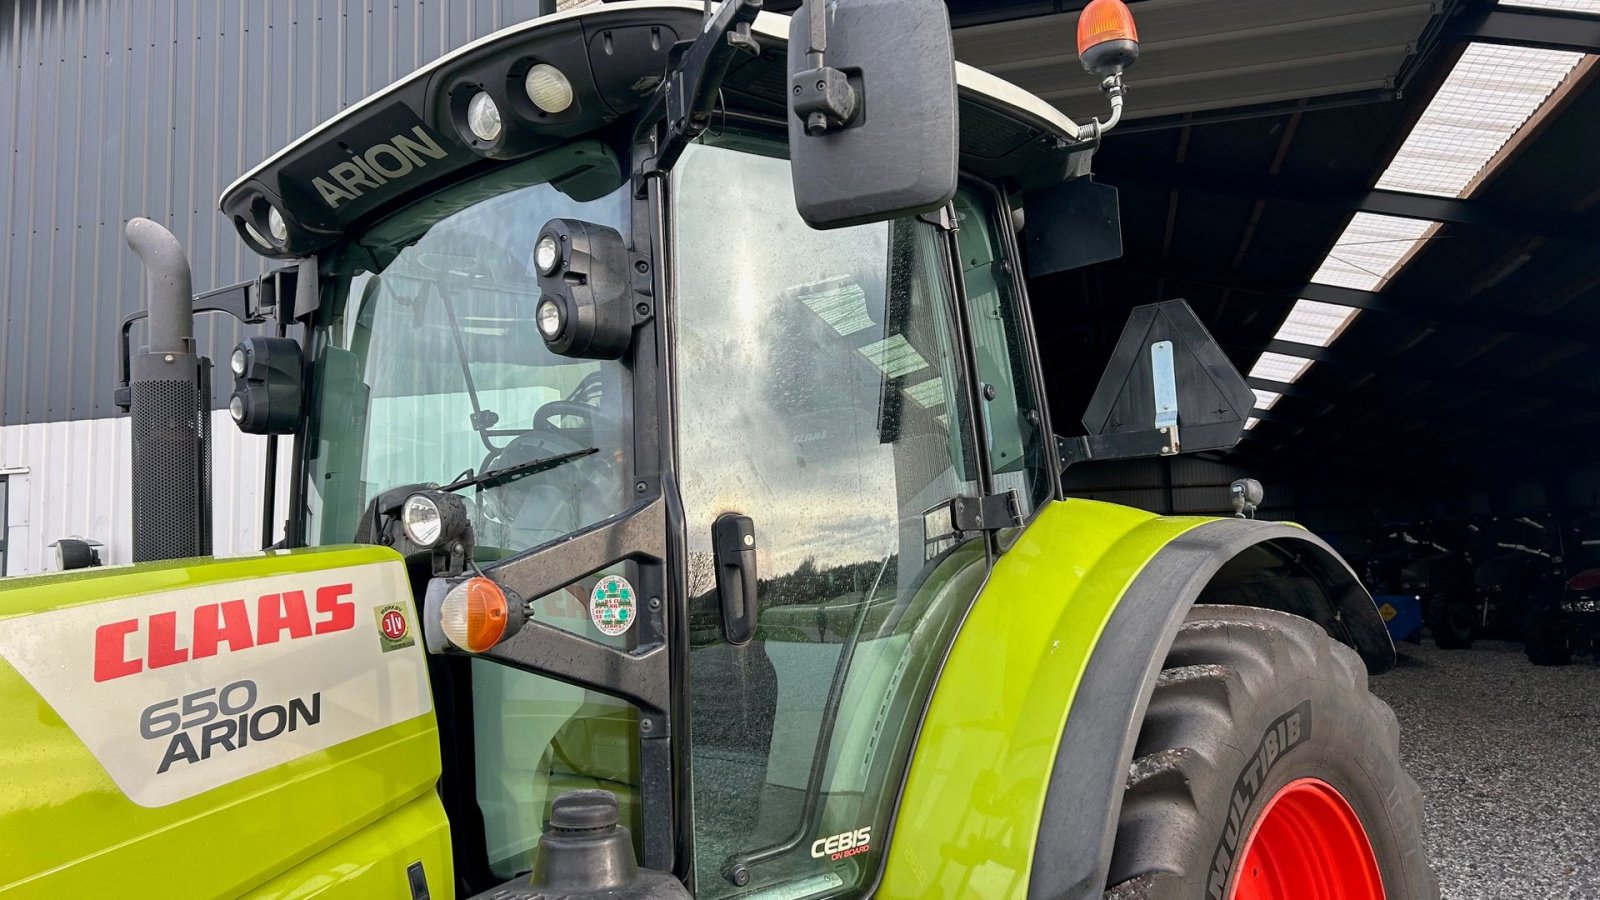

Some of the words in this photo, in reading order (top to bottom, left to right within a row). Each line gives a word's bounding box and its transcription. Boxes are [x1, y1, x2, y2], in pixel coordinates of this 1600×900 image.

[311, 125, 448, 209] ARION
[94, 583, 356, 683] CLAAS
[140, 679, 258, 740] 650
[156, 692, 321, 775] ARION
[811, 826, 871, 859] CEBIS
[1208, 712, 1301, 900] MULTIBIB
[832, 853, 844, 861] ON
[844, 845, 869, 858] BOARD
